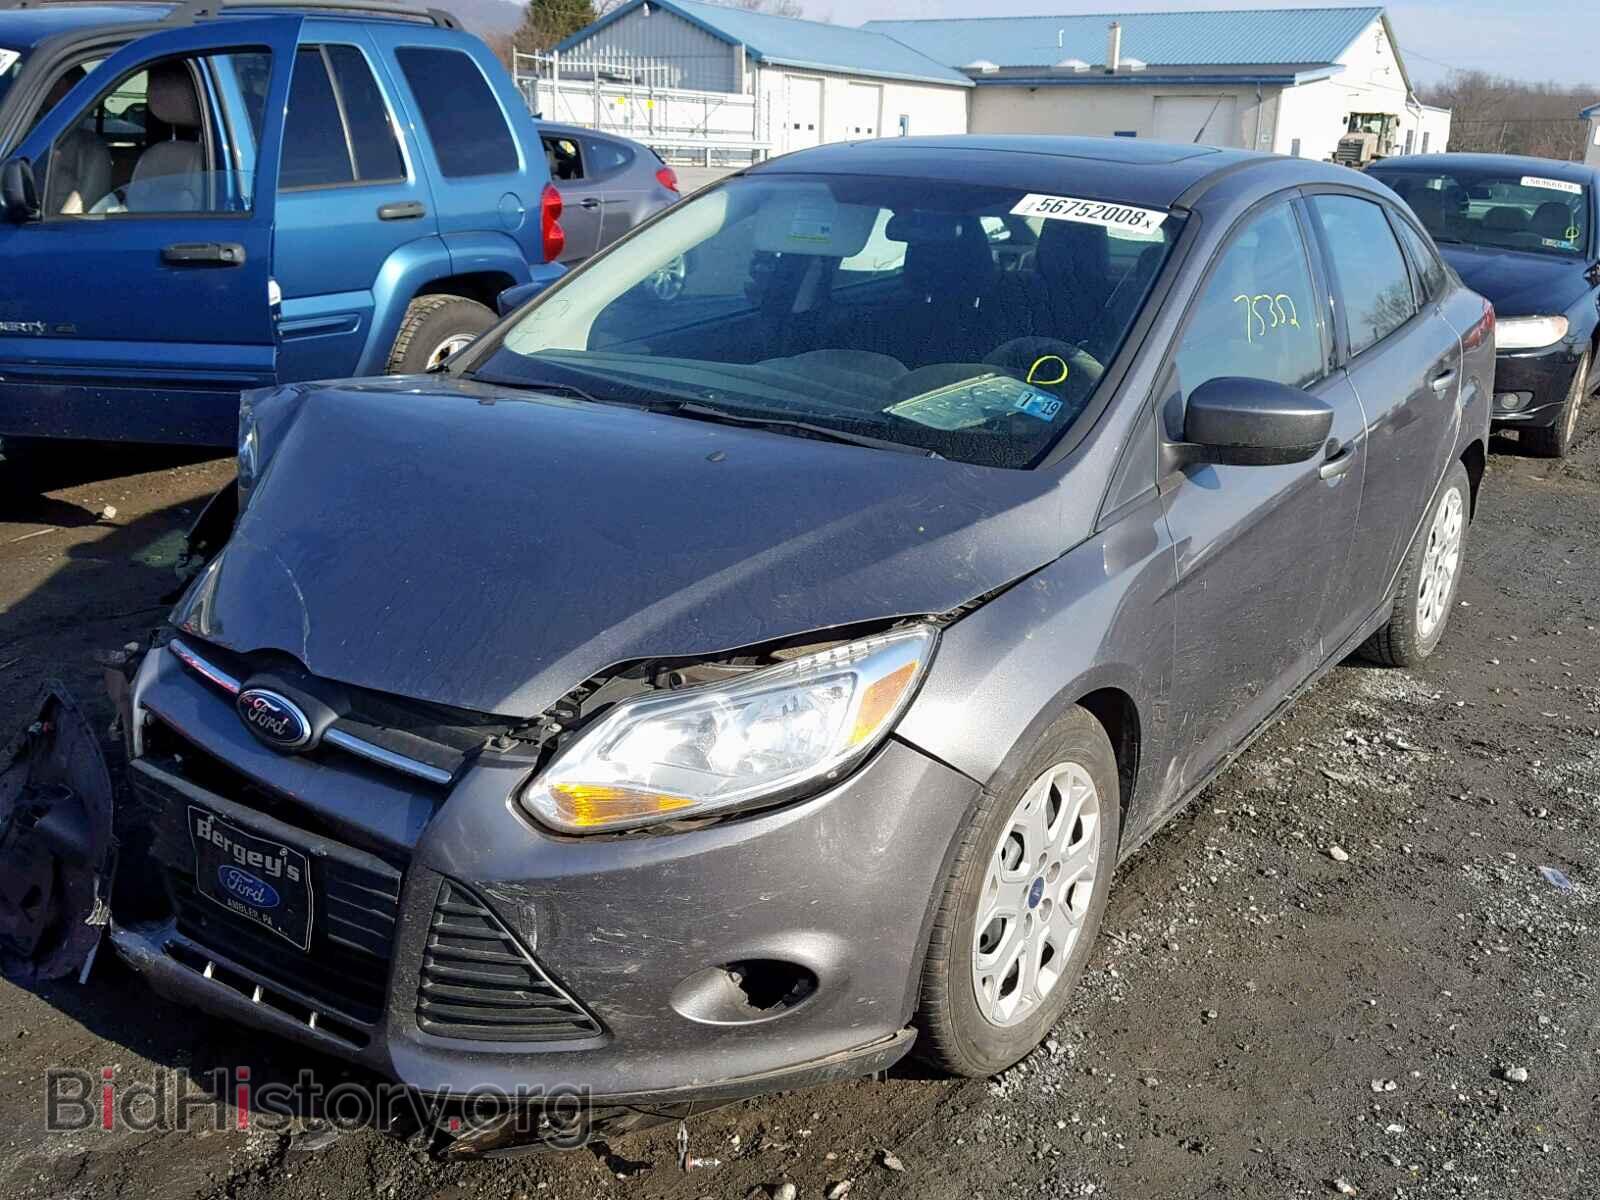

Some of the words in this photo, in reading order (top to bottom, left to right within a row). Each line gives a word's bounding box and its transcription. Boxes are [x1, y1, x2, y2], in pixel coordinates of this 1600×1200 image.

[1036, 197, 1147, 226] 56752008
[1041, 401, 1059, 415] 19
[247, 697, 289, 736] Ford
[196, 816, 301, 883] Bergey's
[226, 869, 265, 903] Ford
